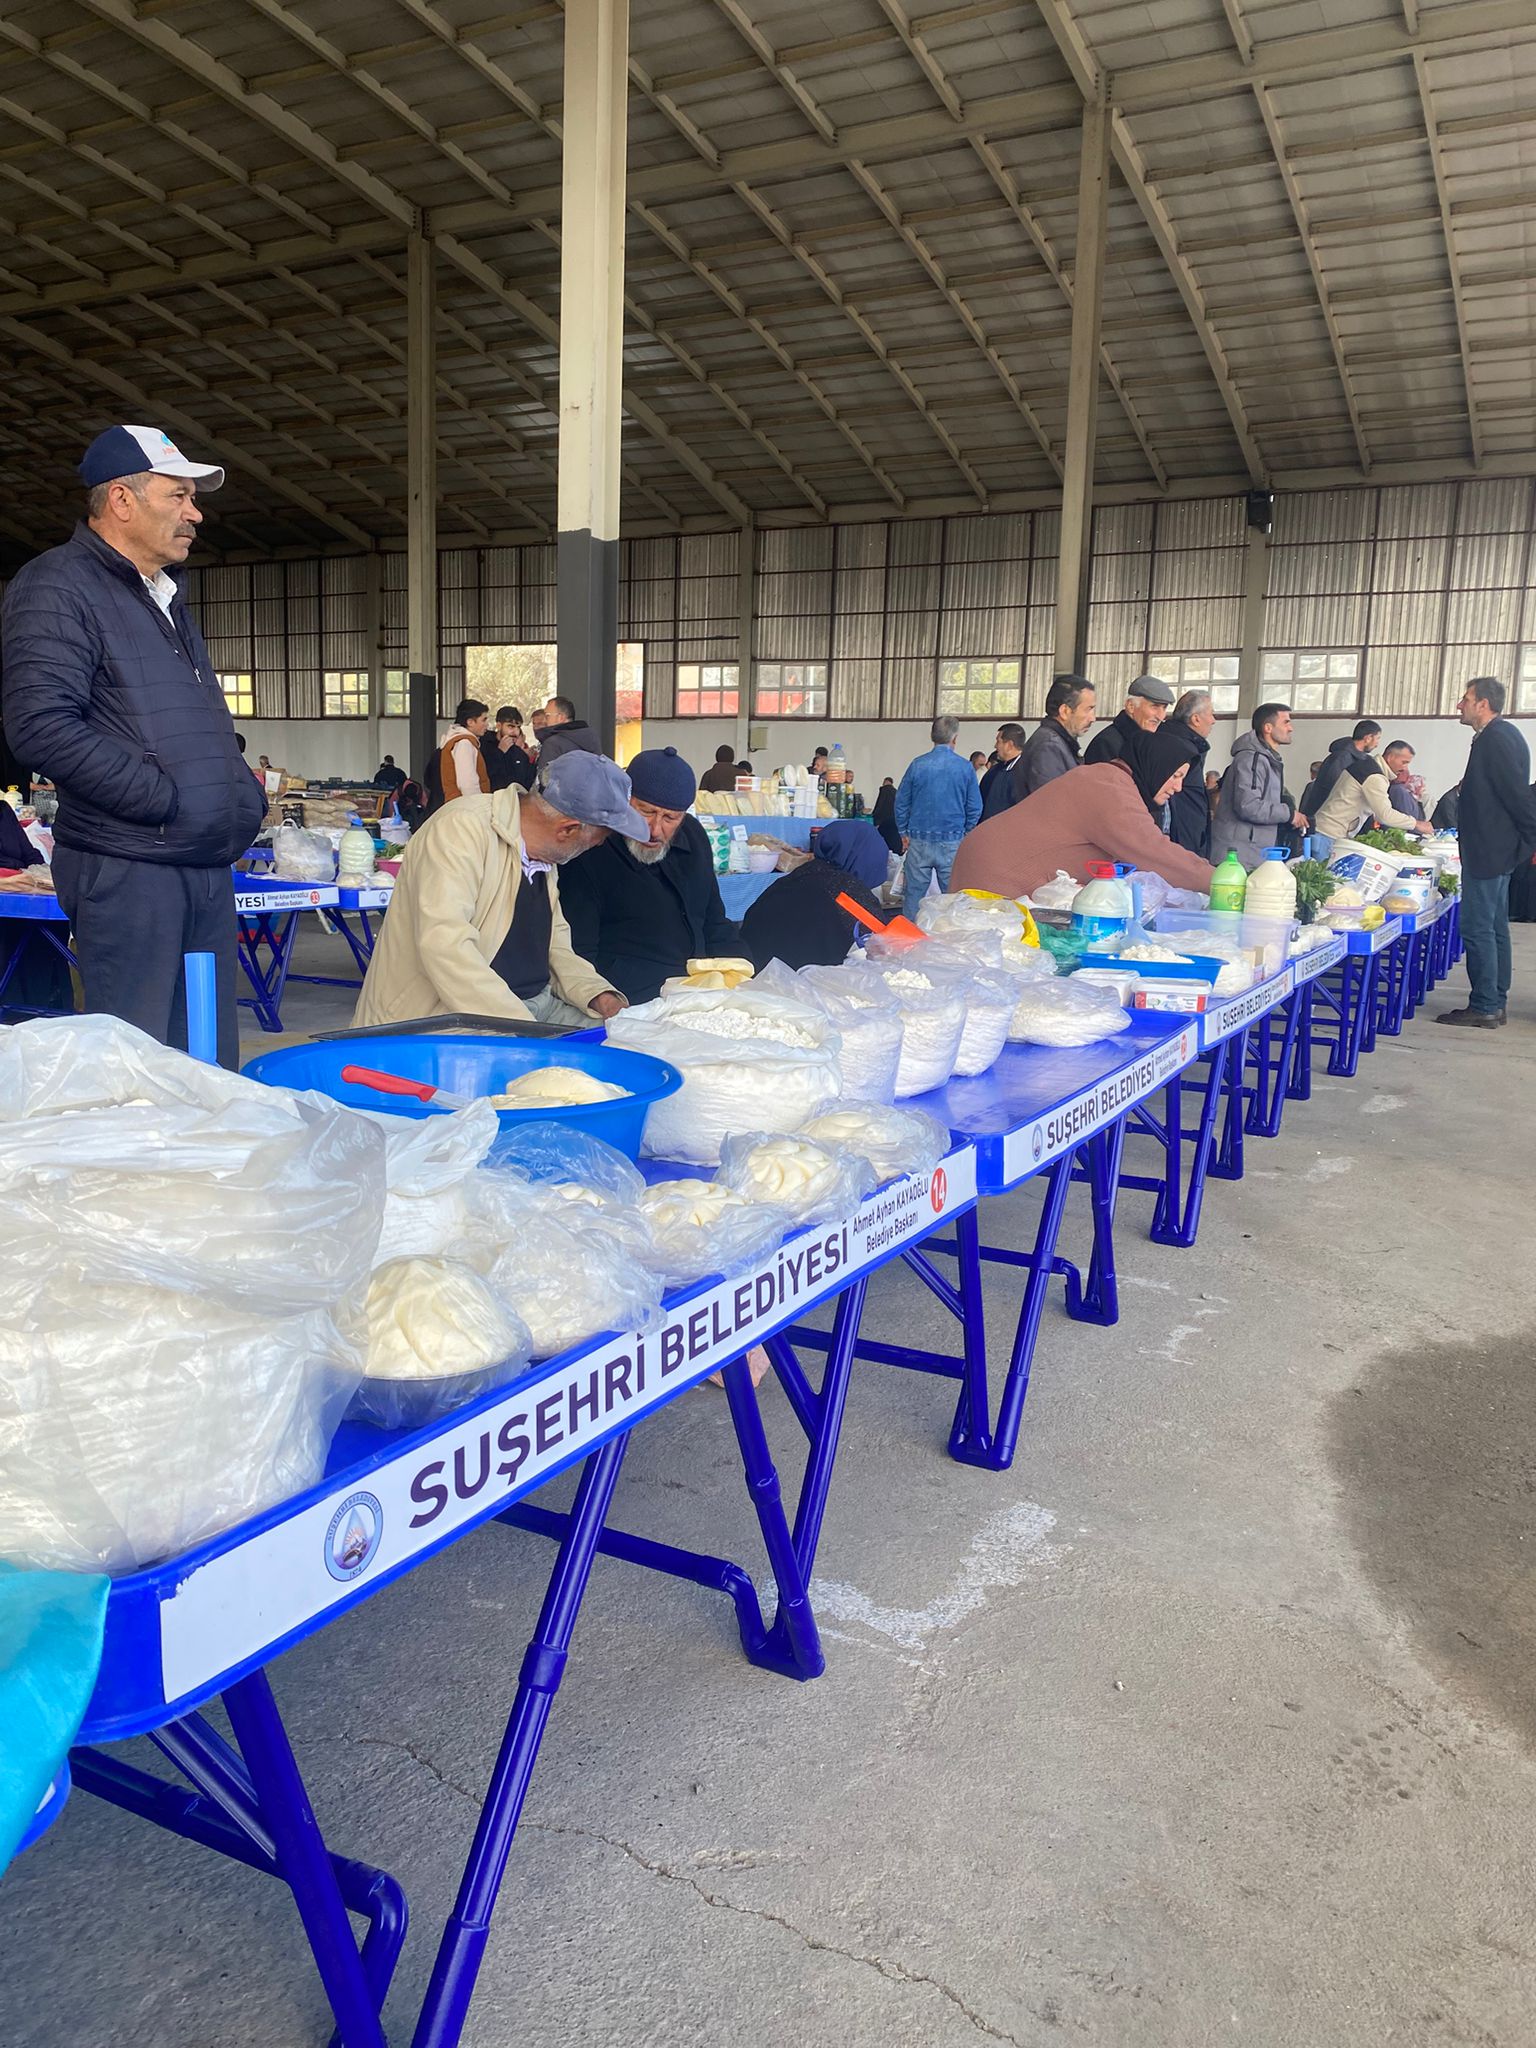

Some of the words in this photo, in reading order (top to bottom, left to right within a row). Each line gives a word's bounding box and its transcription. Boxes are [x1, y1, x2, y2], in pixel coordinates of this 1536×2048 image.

[1047, 1088, 1099, 1149] SUŞEHRİ
[1101, 1054, 1155, 1116] BELEDİYESİ
[853, 1208, 875, 1236] Ahmet
[876, 1199, 896, 1225] Ayhan
[896, 1177, 929, 1211] KAYAOĞLU
[932, 1172, 946, 1209] 14
[866, 1226, 893, 1254] Belediye
[894, 1211, 918, 1235] Başkanı
[408, 1332, 647, 1529] SUŞEHRİ
[659, 1220, 848, 1378] BELEDİYESİ
